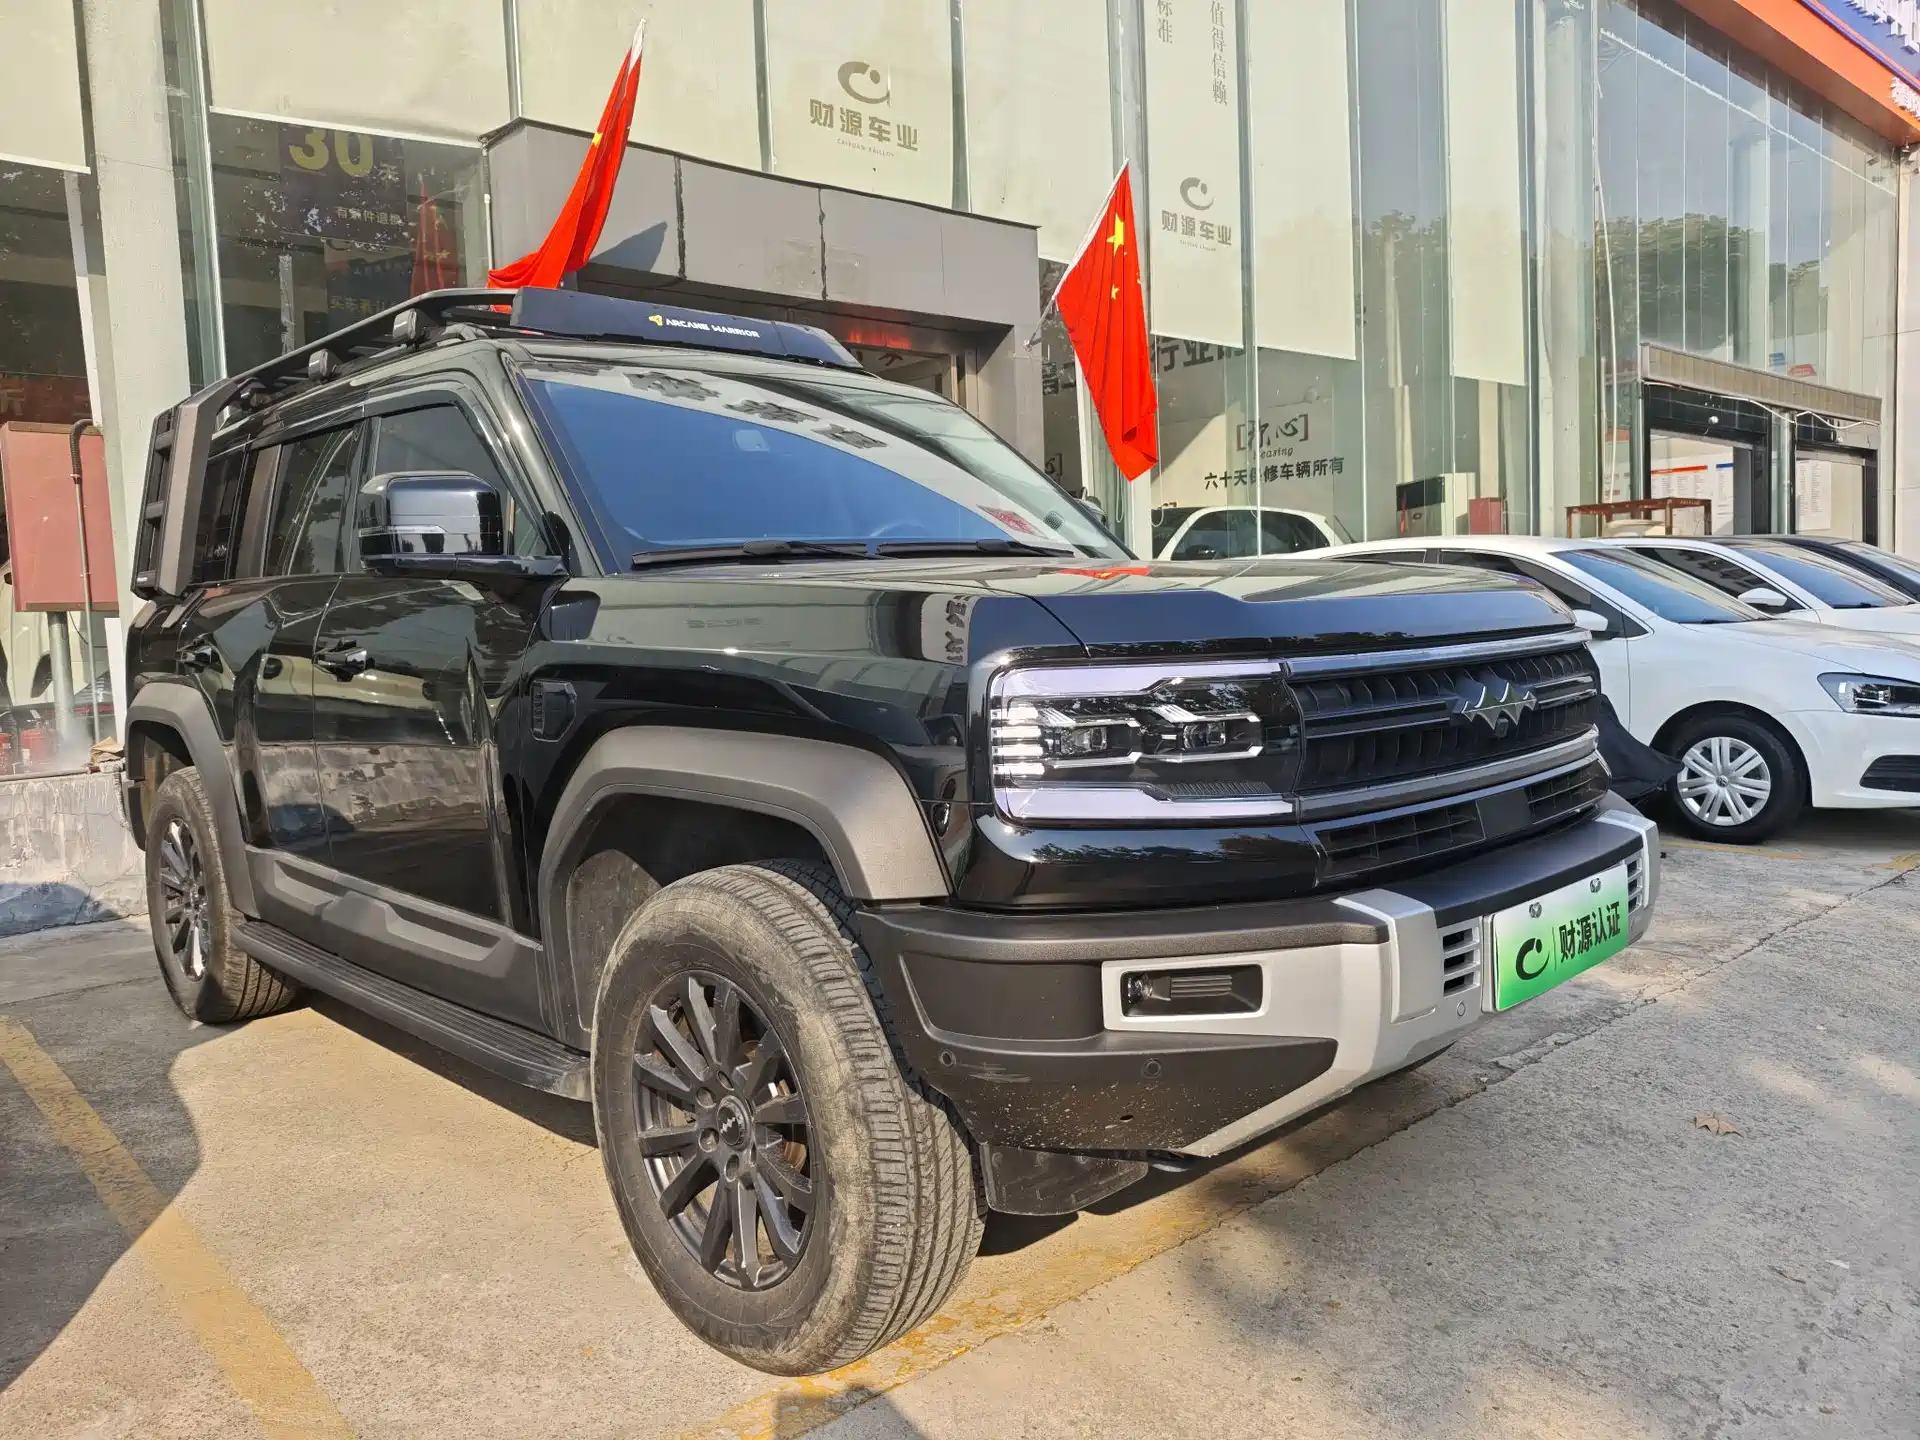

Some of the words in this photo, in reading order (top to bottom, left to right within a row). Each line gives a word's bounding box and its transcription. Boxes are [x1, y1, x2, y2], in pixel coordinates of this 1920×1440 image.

[1211, 0, 1227, 106] 值得信赖
[809, 98, 918, 151] 财源车业
[1161, 209, 1232, 246] 财源车业
[711, 325, 760, 338] WARRIOR
[1559, 901, 1621, 963] 财源认证
